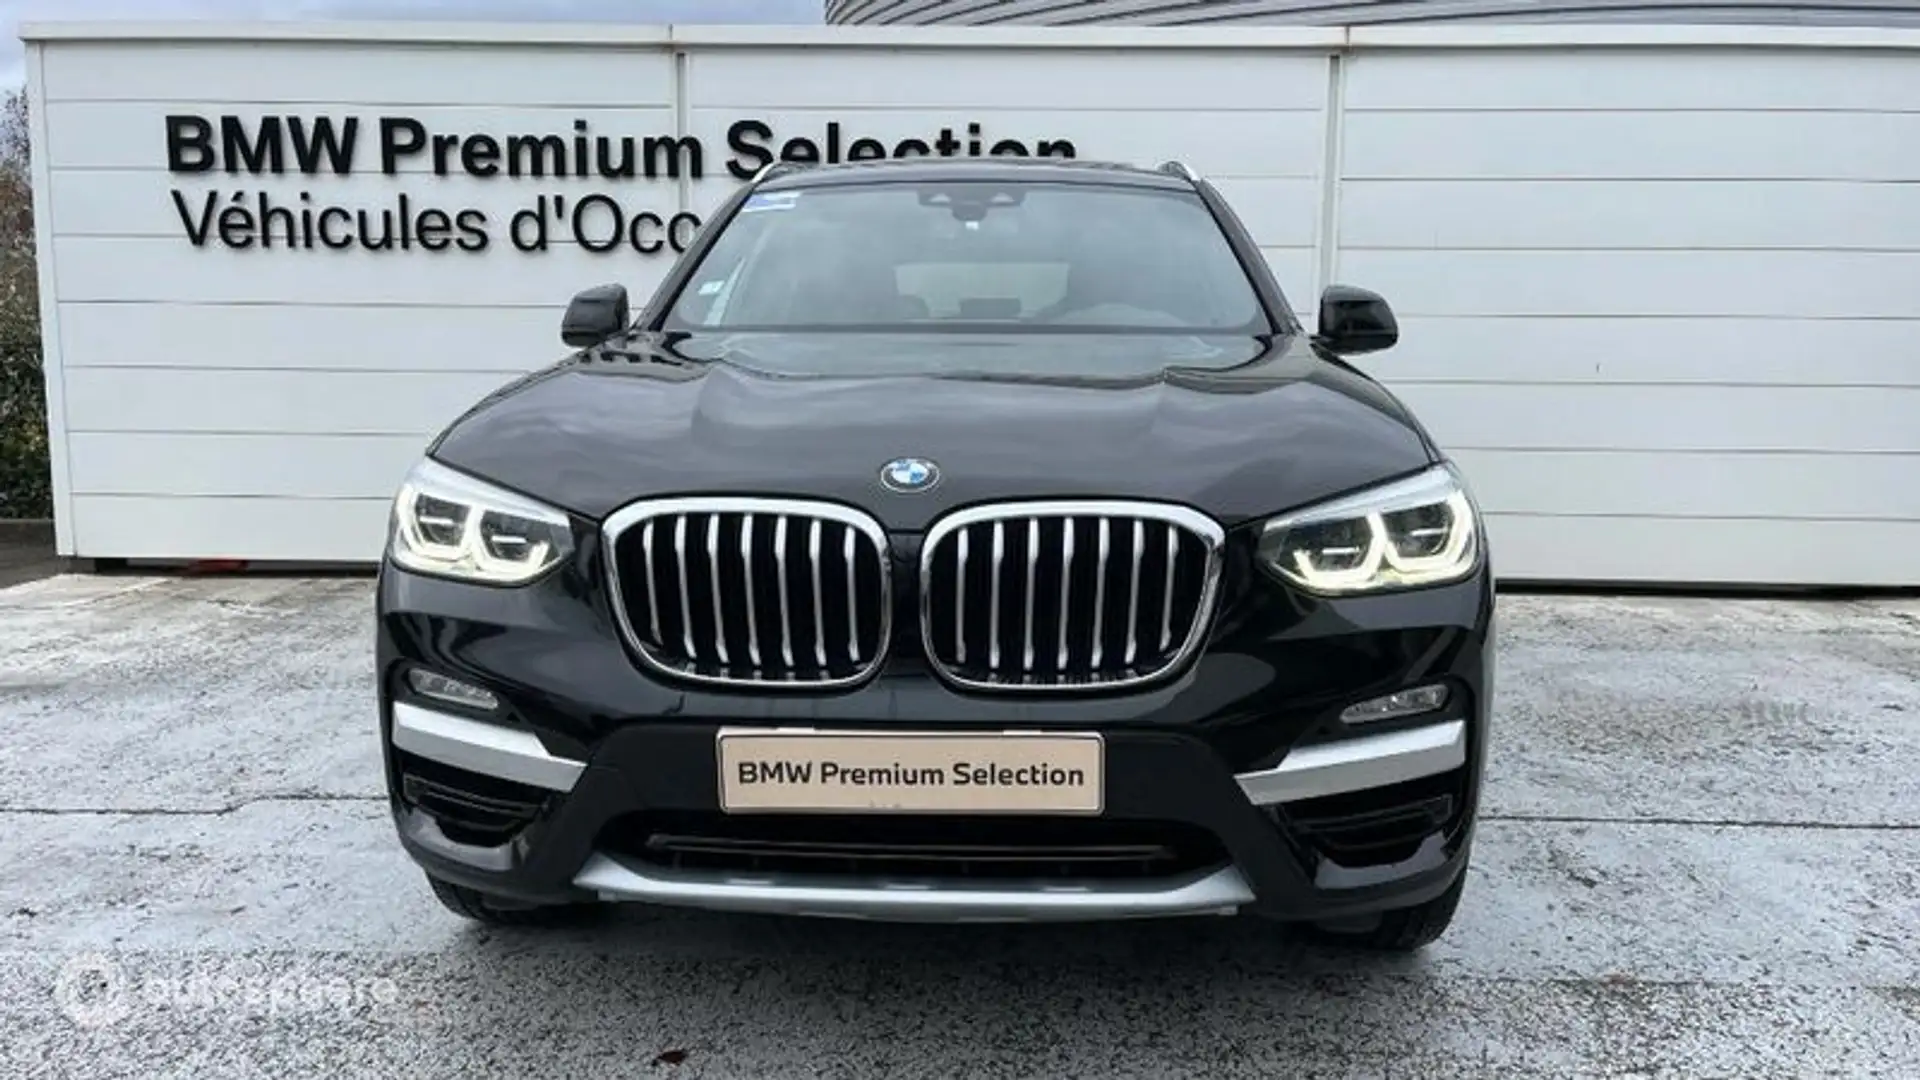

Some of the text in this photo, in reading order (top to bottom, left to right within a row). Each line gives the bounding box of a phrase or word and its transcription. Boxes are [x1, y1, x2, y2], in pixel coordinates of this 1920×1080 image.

[165, 115, 358, 176] BMW
[380, 116, 703, 178] Premium
[171, 190, 488, 250] Véhicules
[738, 761, 1085, 786] BMW Premium Selection
